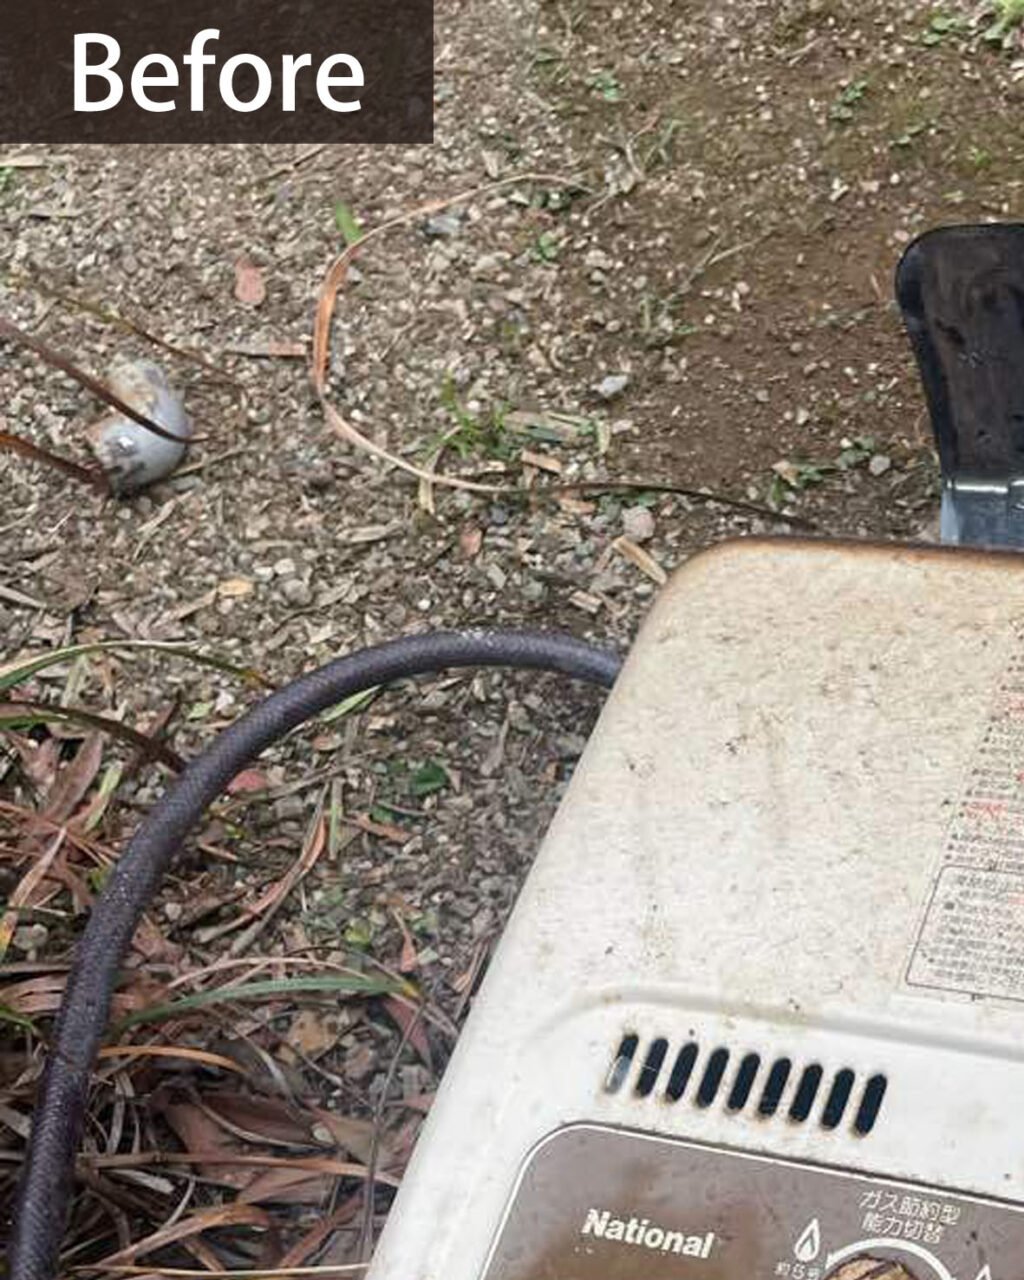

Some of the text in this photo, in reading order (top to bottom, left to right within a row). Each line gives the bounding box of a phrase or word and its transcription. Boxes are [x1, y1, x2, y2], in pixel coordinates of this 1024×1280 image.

[859, 1190, 961, 1225] ガス節約型
[580, 1208, 715, 1260] National
[861, 1212, 947, 1244] 能力切替
